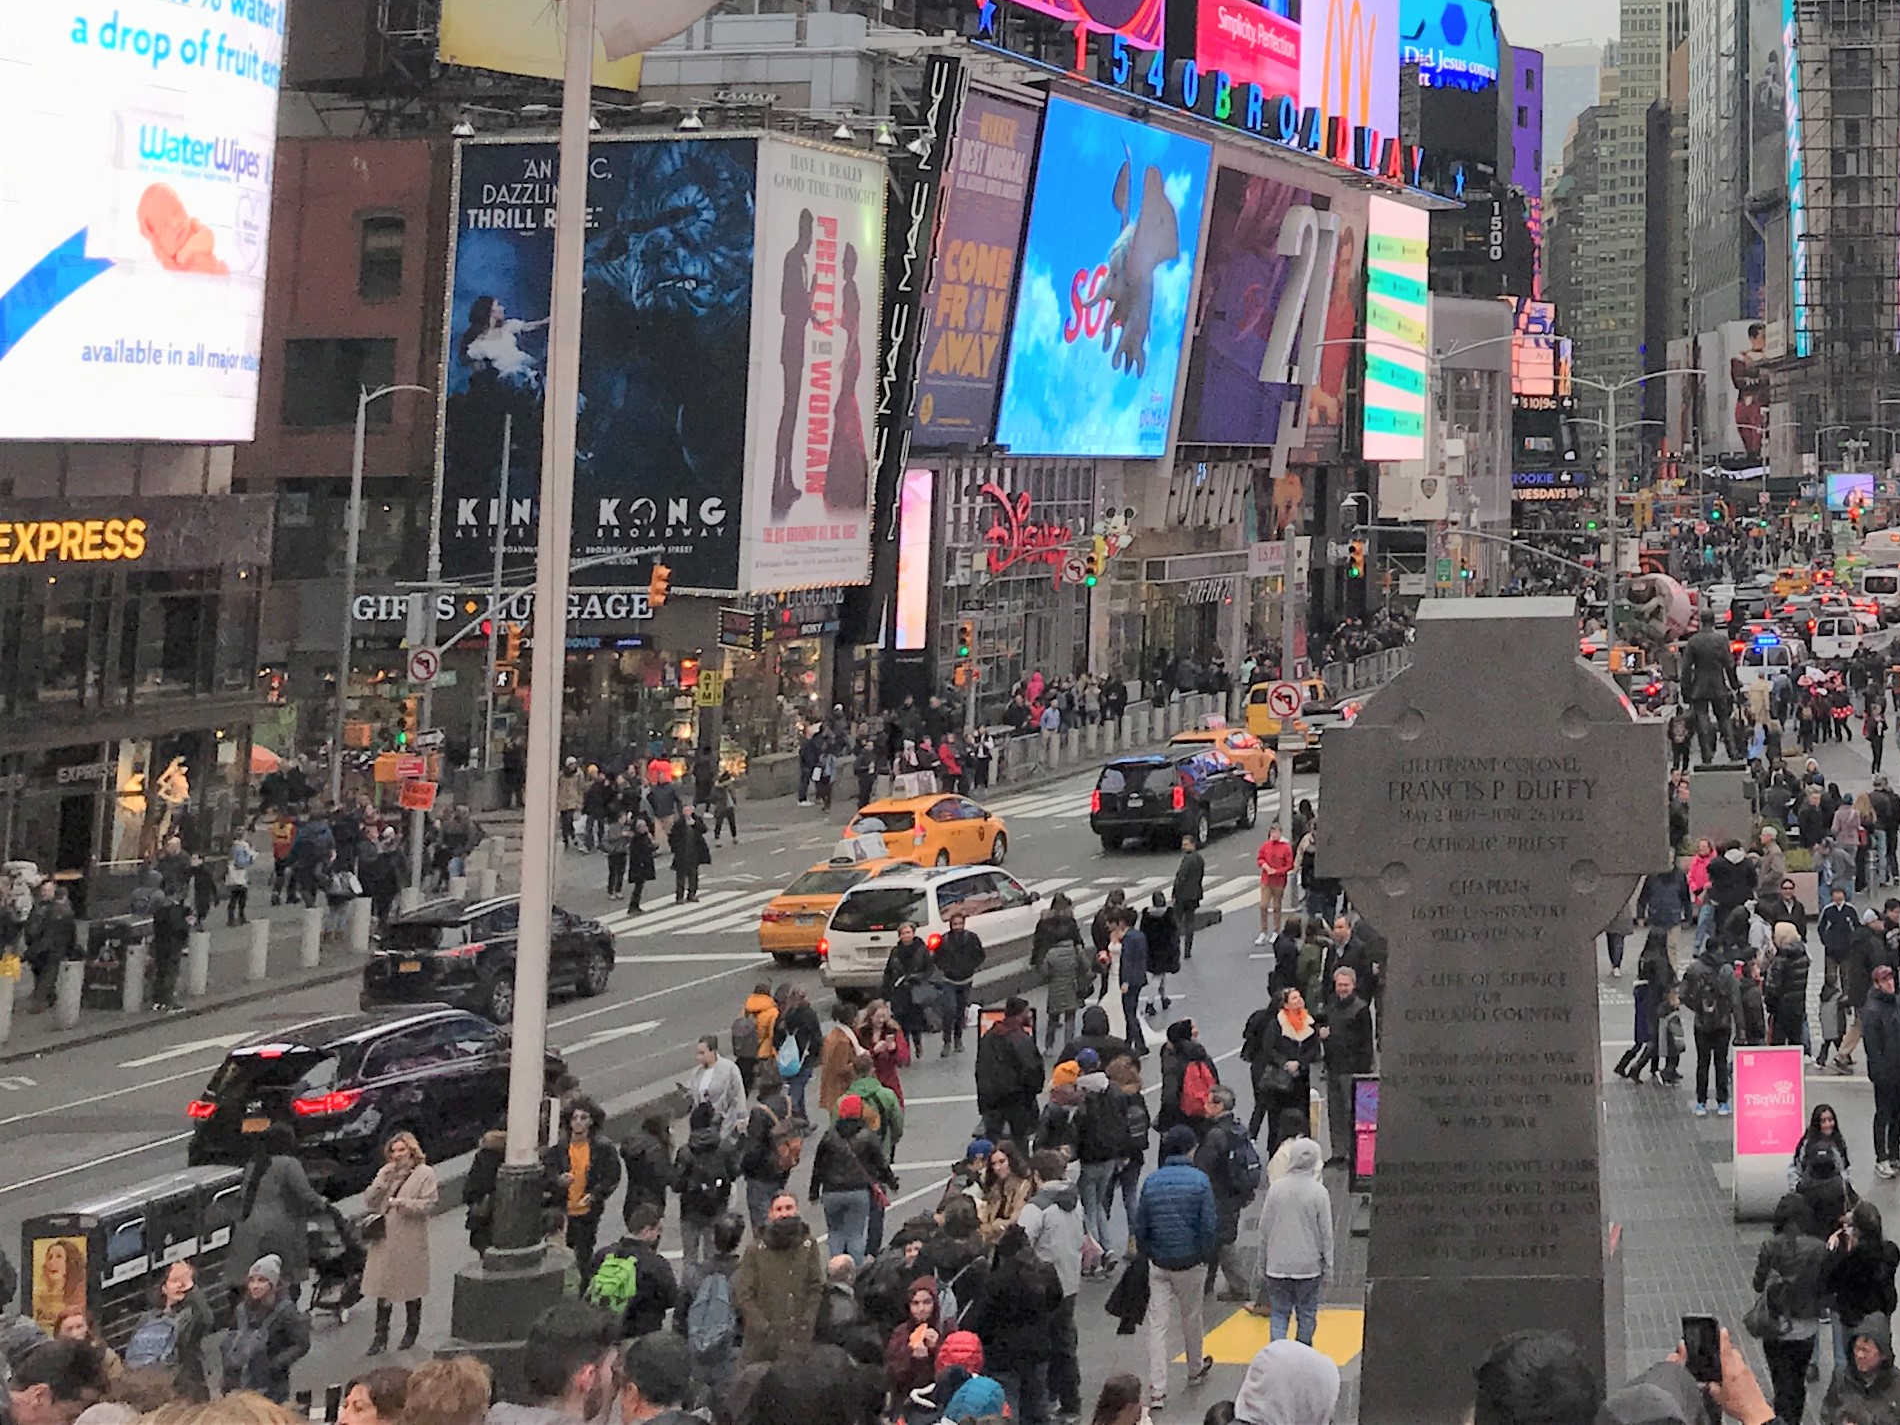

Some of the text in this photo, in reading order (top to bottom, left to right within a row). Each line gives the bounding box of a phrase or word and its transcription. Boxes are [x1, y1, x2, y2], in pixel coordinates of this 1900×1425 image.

[71, 16, 88, 44] a
[99, 10, 171, 68] drop
[180, 29, 209, 64] of
[216, 33, 260, 79] fruit
[1436, 50, 1467, 73] Jesus
[1073, 21, 1198, 108] 1540
[139, 124, 260, 186] WaterWipes
[790, 153, 816, 175] HAVE
[774, 174, 877, 207] GOOD TIME TONIGHT
[467, 209, 537, 230] THRILL
[1490, 201, 1503, 261] 1500
[811, 215, 838, 336] PRETTY
[945, 239, 1013, 287] COME
[81, 339, 162, 367] available
[168, 343, 184, 366] in
[188, 343, 205, 367] all
[207, 352, 241, 375] major
[926, 330, 999, 380] AWAY
[805, 361, 832, 495] WOMAN
[600, 497, 727, 526] KONG
[0, 517, 147, 565] EXPRESS
[597, 527, 725, 538] BROADWAY
[353, 594, 456, 621] GIFS
[702, 671, 713, 702] ATM
[1387, 779, 1598, 802] FRANCIS P DUFFY
[1412, 835, 1570, 853] CATHOLIC PRIEST
